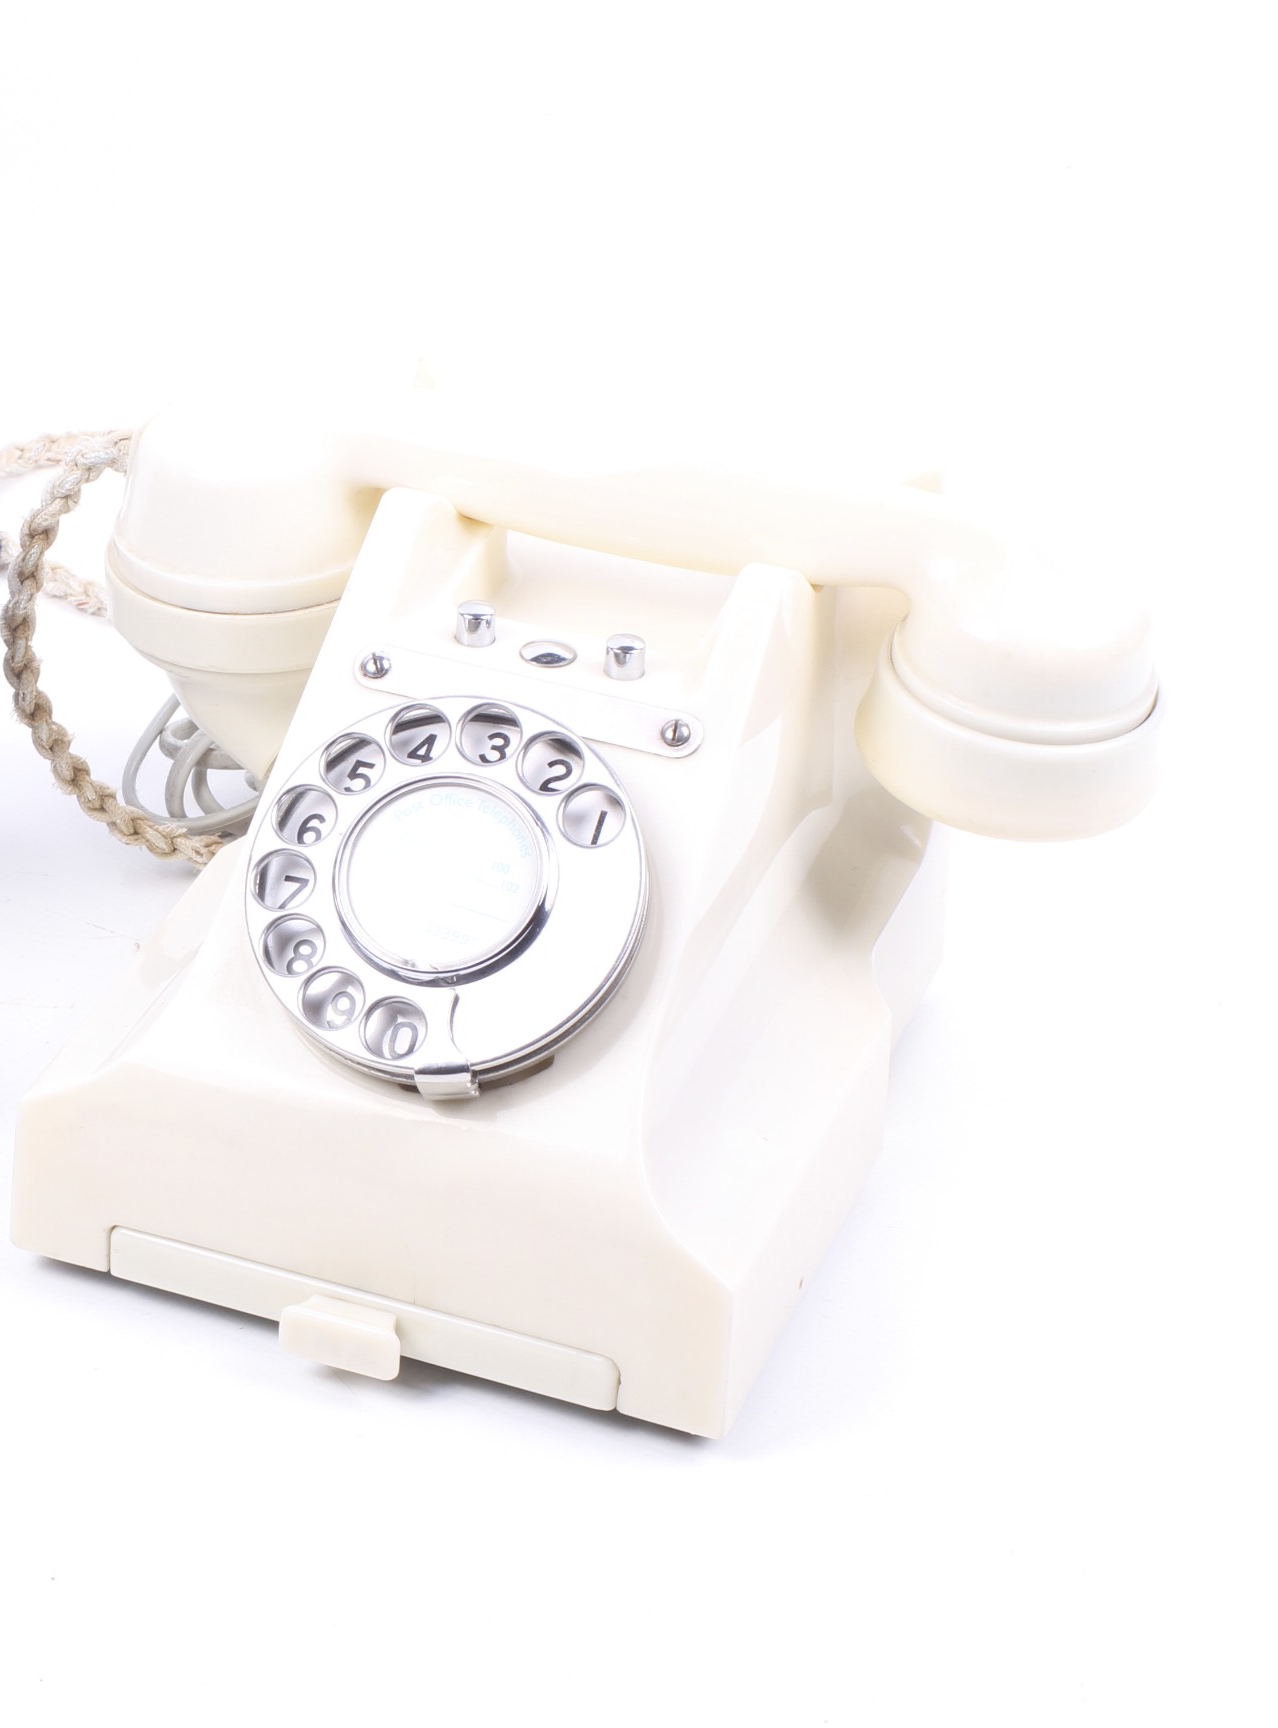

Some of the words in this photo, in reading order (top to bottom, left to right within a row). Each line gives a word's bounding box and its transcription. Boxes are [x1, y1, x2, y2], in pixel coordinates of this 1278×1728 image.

[407, 733, 438, 763] 4
[478, 732, 510, 764] 3
[344, 760, 375, 793] 5
[539, 759, 573, 792] 2
[297, 814, 326, 845] 6
[393, 800, 425, 822] Post
[429, 793, 473, 808] Office
[476, 798, 531, 858] Telephones
[591, 809, 608, 845] 1
[278, 875, 309, 909] 7
[286, 939, 318, 975] 8
[327, 991, 356, 1027] 9
[389, 1022, 418, 1057] 0
